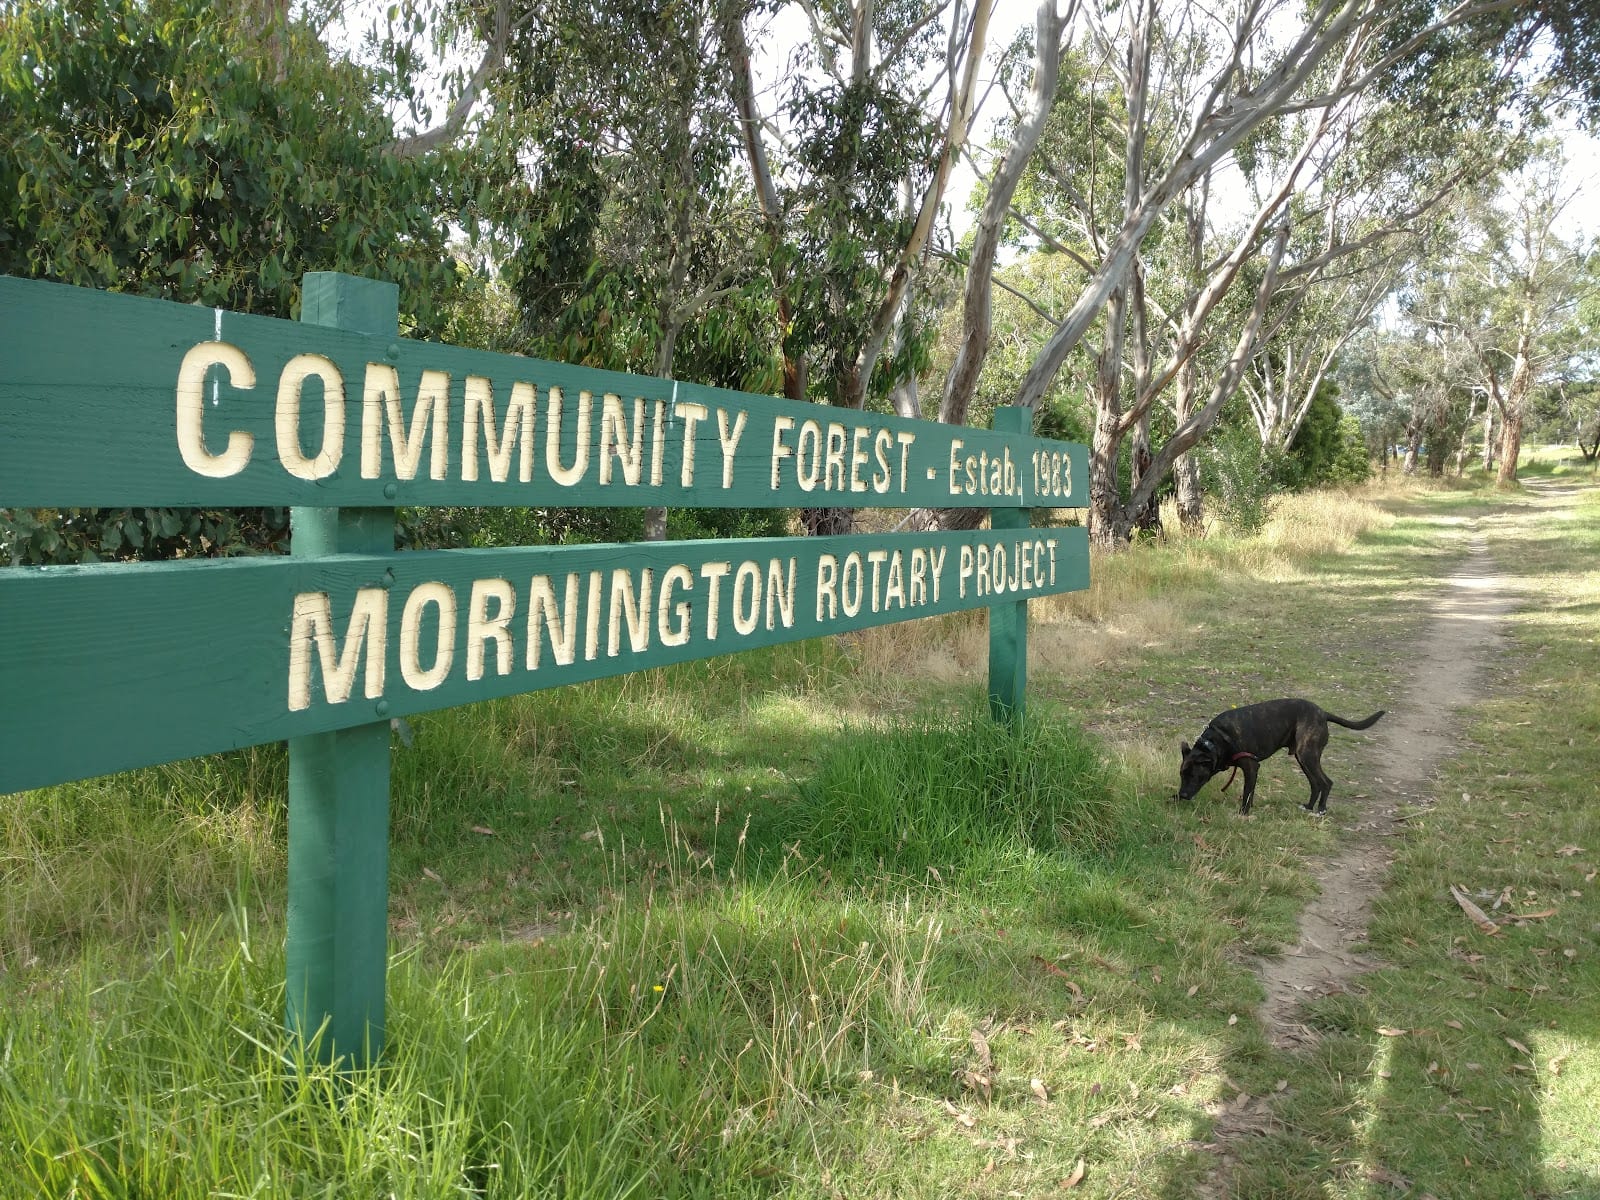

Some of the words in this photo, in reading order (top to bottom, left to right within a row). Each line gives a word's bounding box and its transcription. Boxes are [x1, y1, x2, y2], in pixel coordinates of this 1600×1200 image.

[176, 341, 748, 488] COMMUNITY
[770, 416, 915, 493] FOREST
[1031, 449, 1072, 498] 1983
[288, 556, 797, 712] MORNINGTON
[815, 545, 947, 622] ROTARY
[959, 538, 1058, 599] PROJECT
